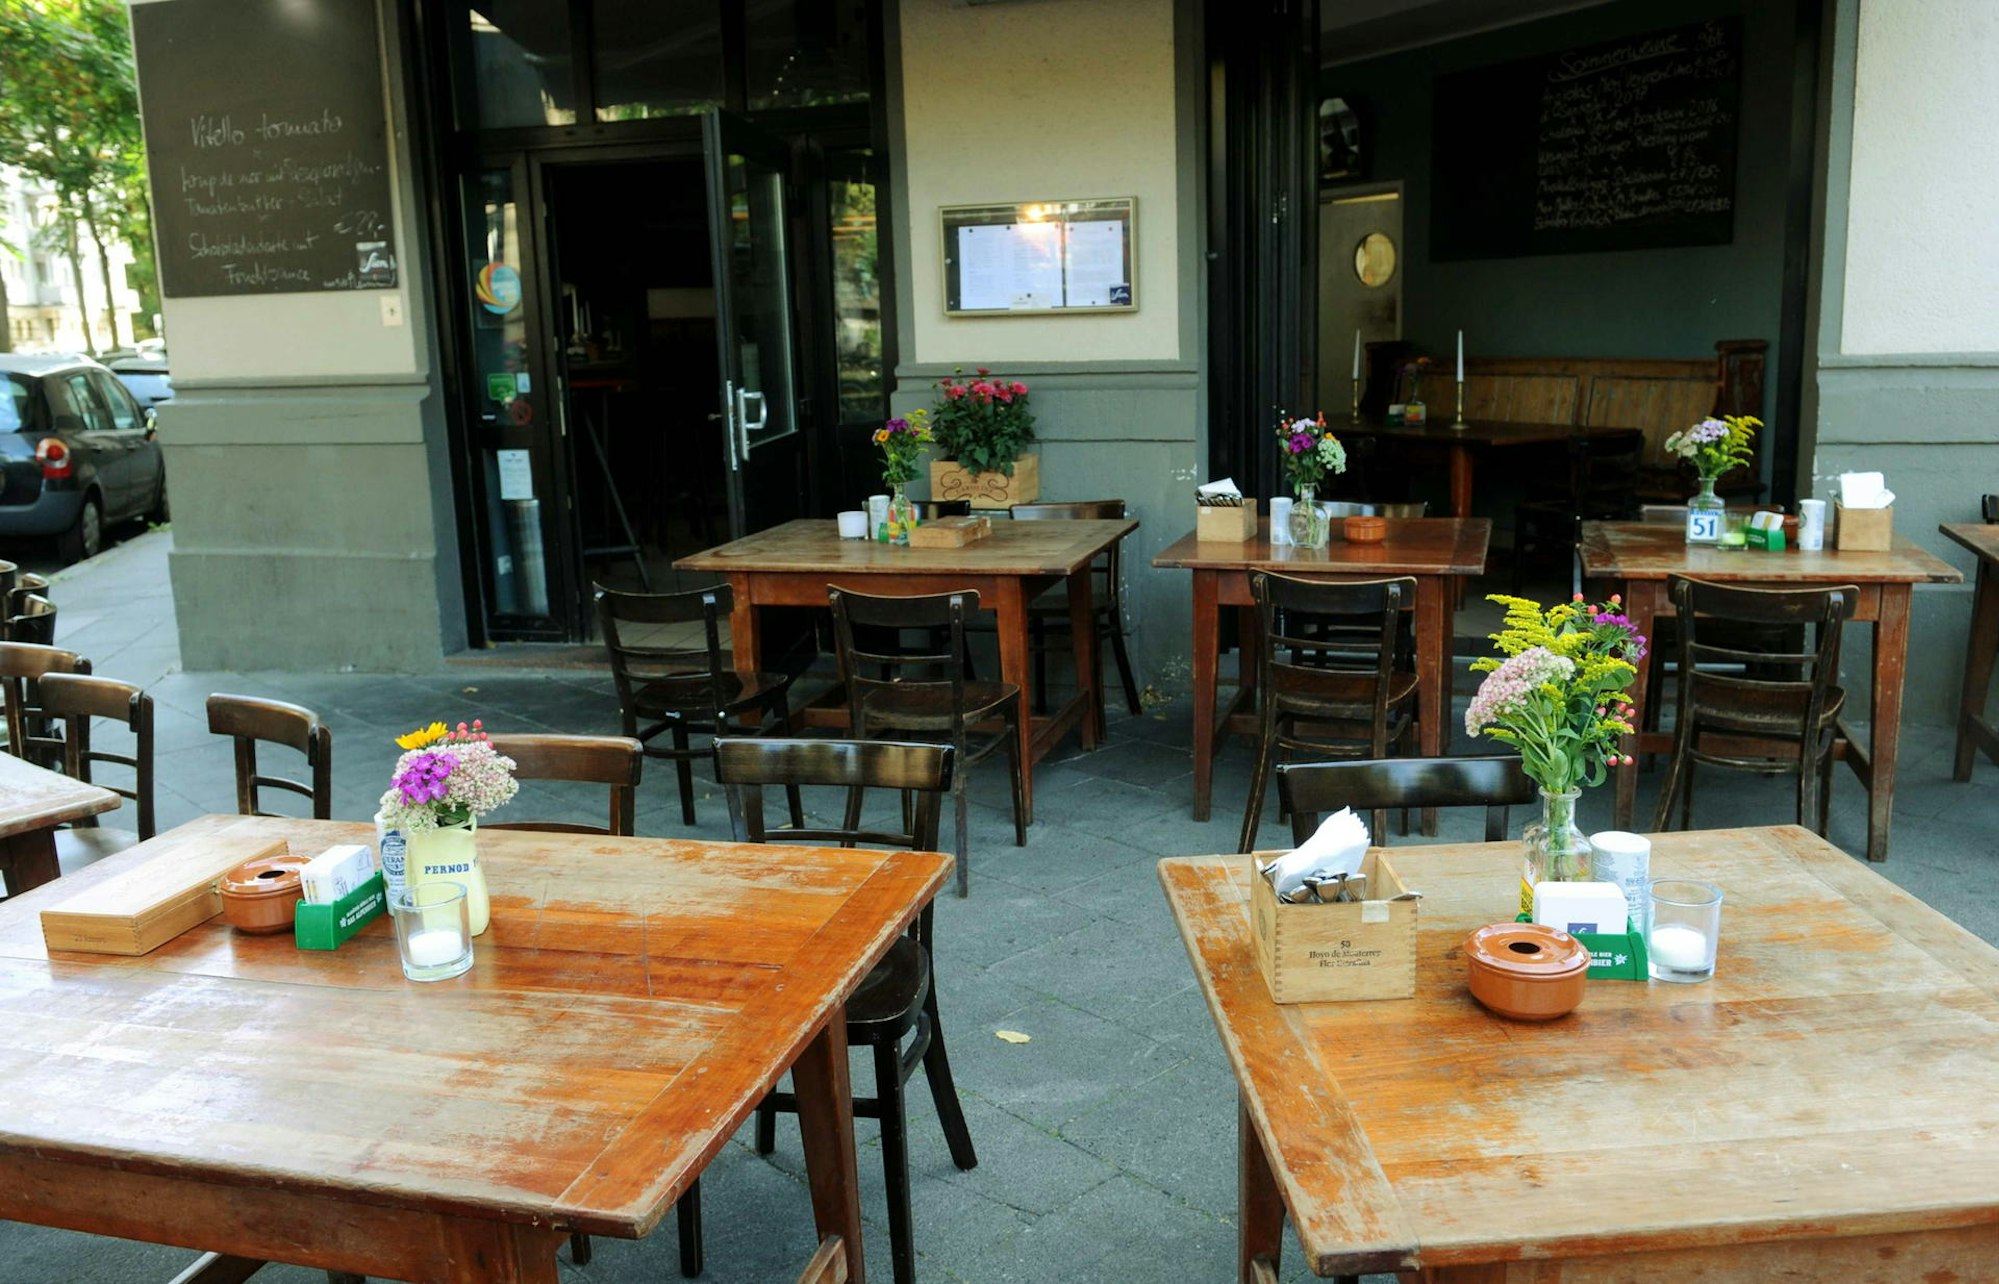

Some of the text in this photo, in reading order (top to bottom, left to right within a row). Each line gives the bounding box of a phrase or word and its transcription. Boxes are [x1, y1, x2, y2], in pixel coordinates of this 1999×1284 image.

[190, 114, 245, 148] Vitello
[1693, 517, 1716, 537] 51
[424, 863, 470, 875] PERNOD
